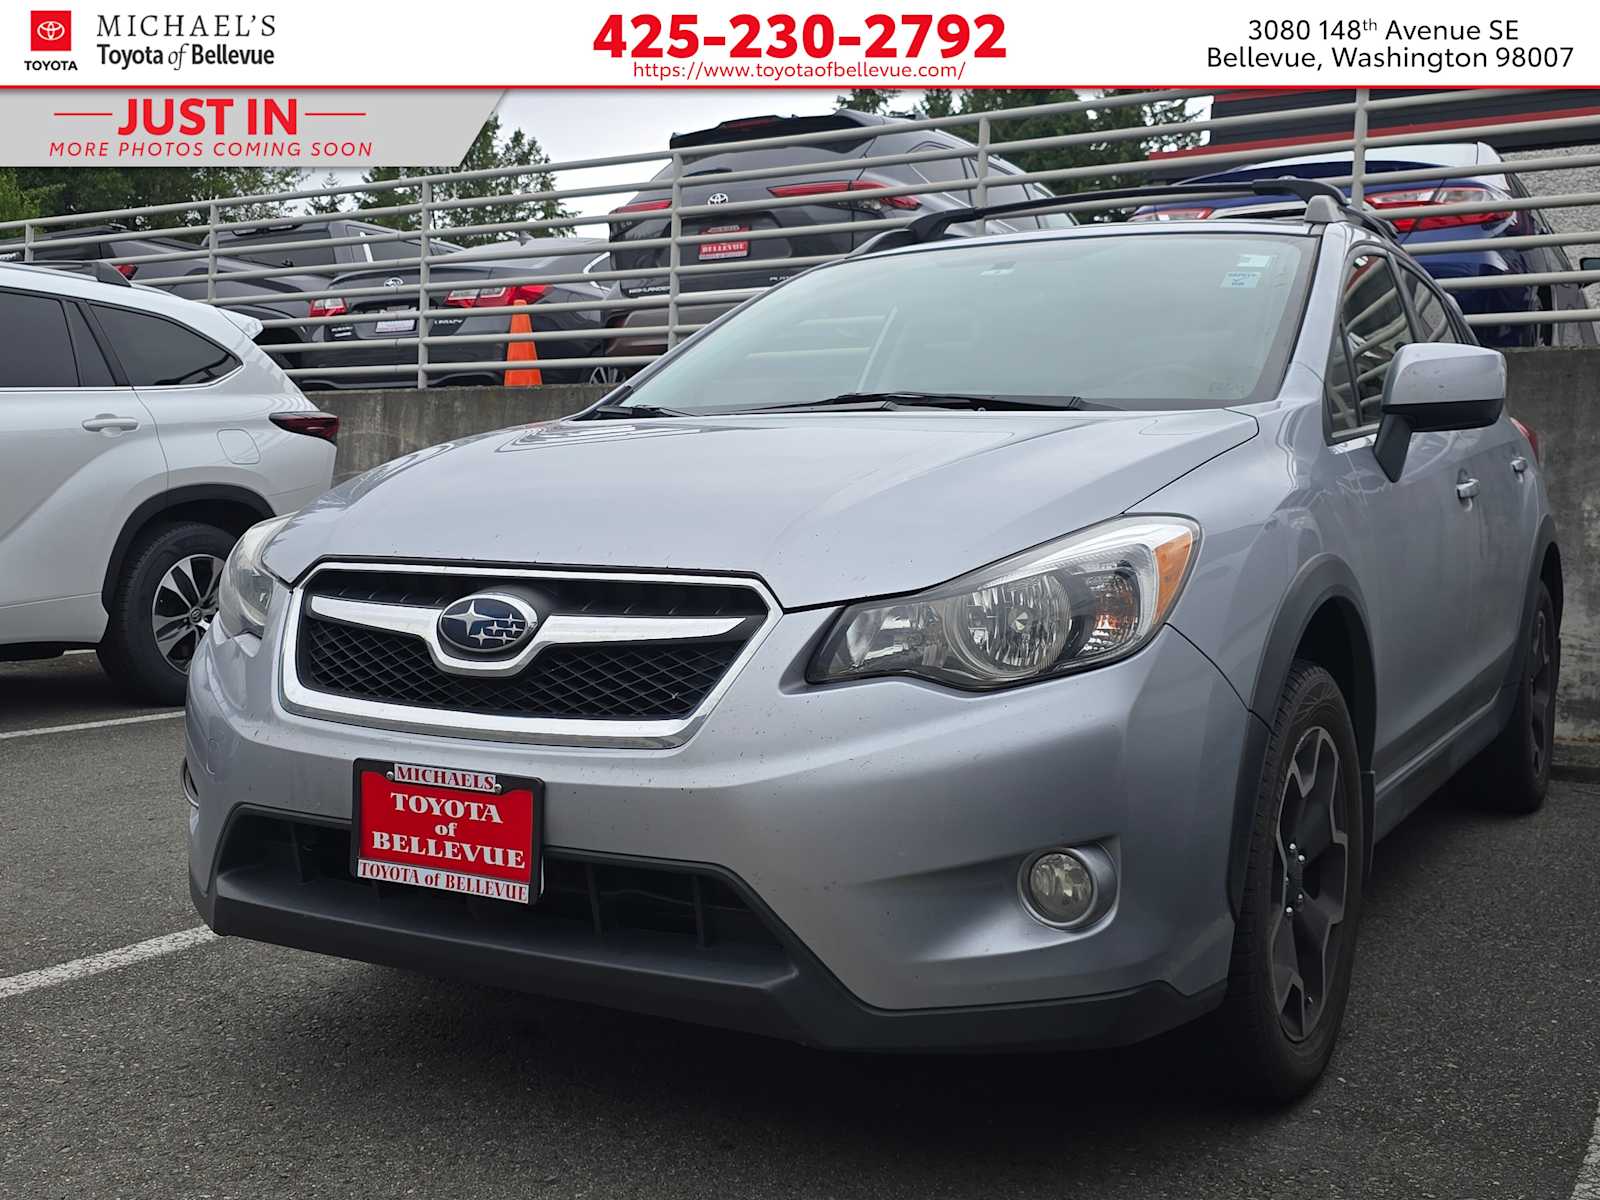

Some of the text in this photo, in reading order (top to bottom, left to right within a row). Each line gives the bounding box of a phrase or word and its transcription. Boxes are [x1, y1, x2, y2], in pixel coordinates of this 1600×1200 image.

[395, 765, 495, 791] MICHAELS
[390, 792, 504, 824] TOYOTA
[434, 822, 458, 837] of
[372, 831, 526, 869] BELLEVUE
[360, 862, 529, 902] TOYOTA of BELLEVUE
